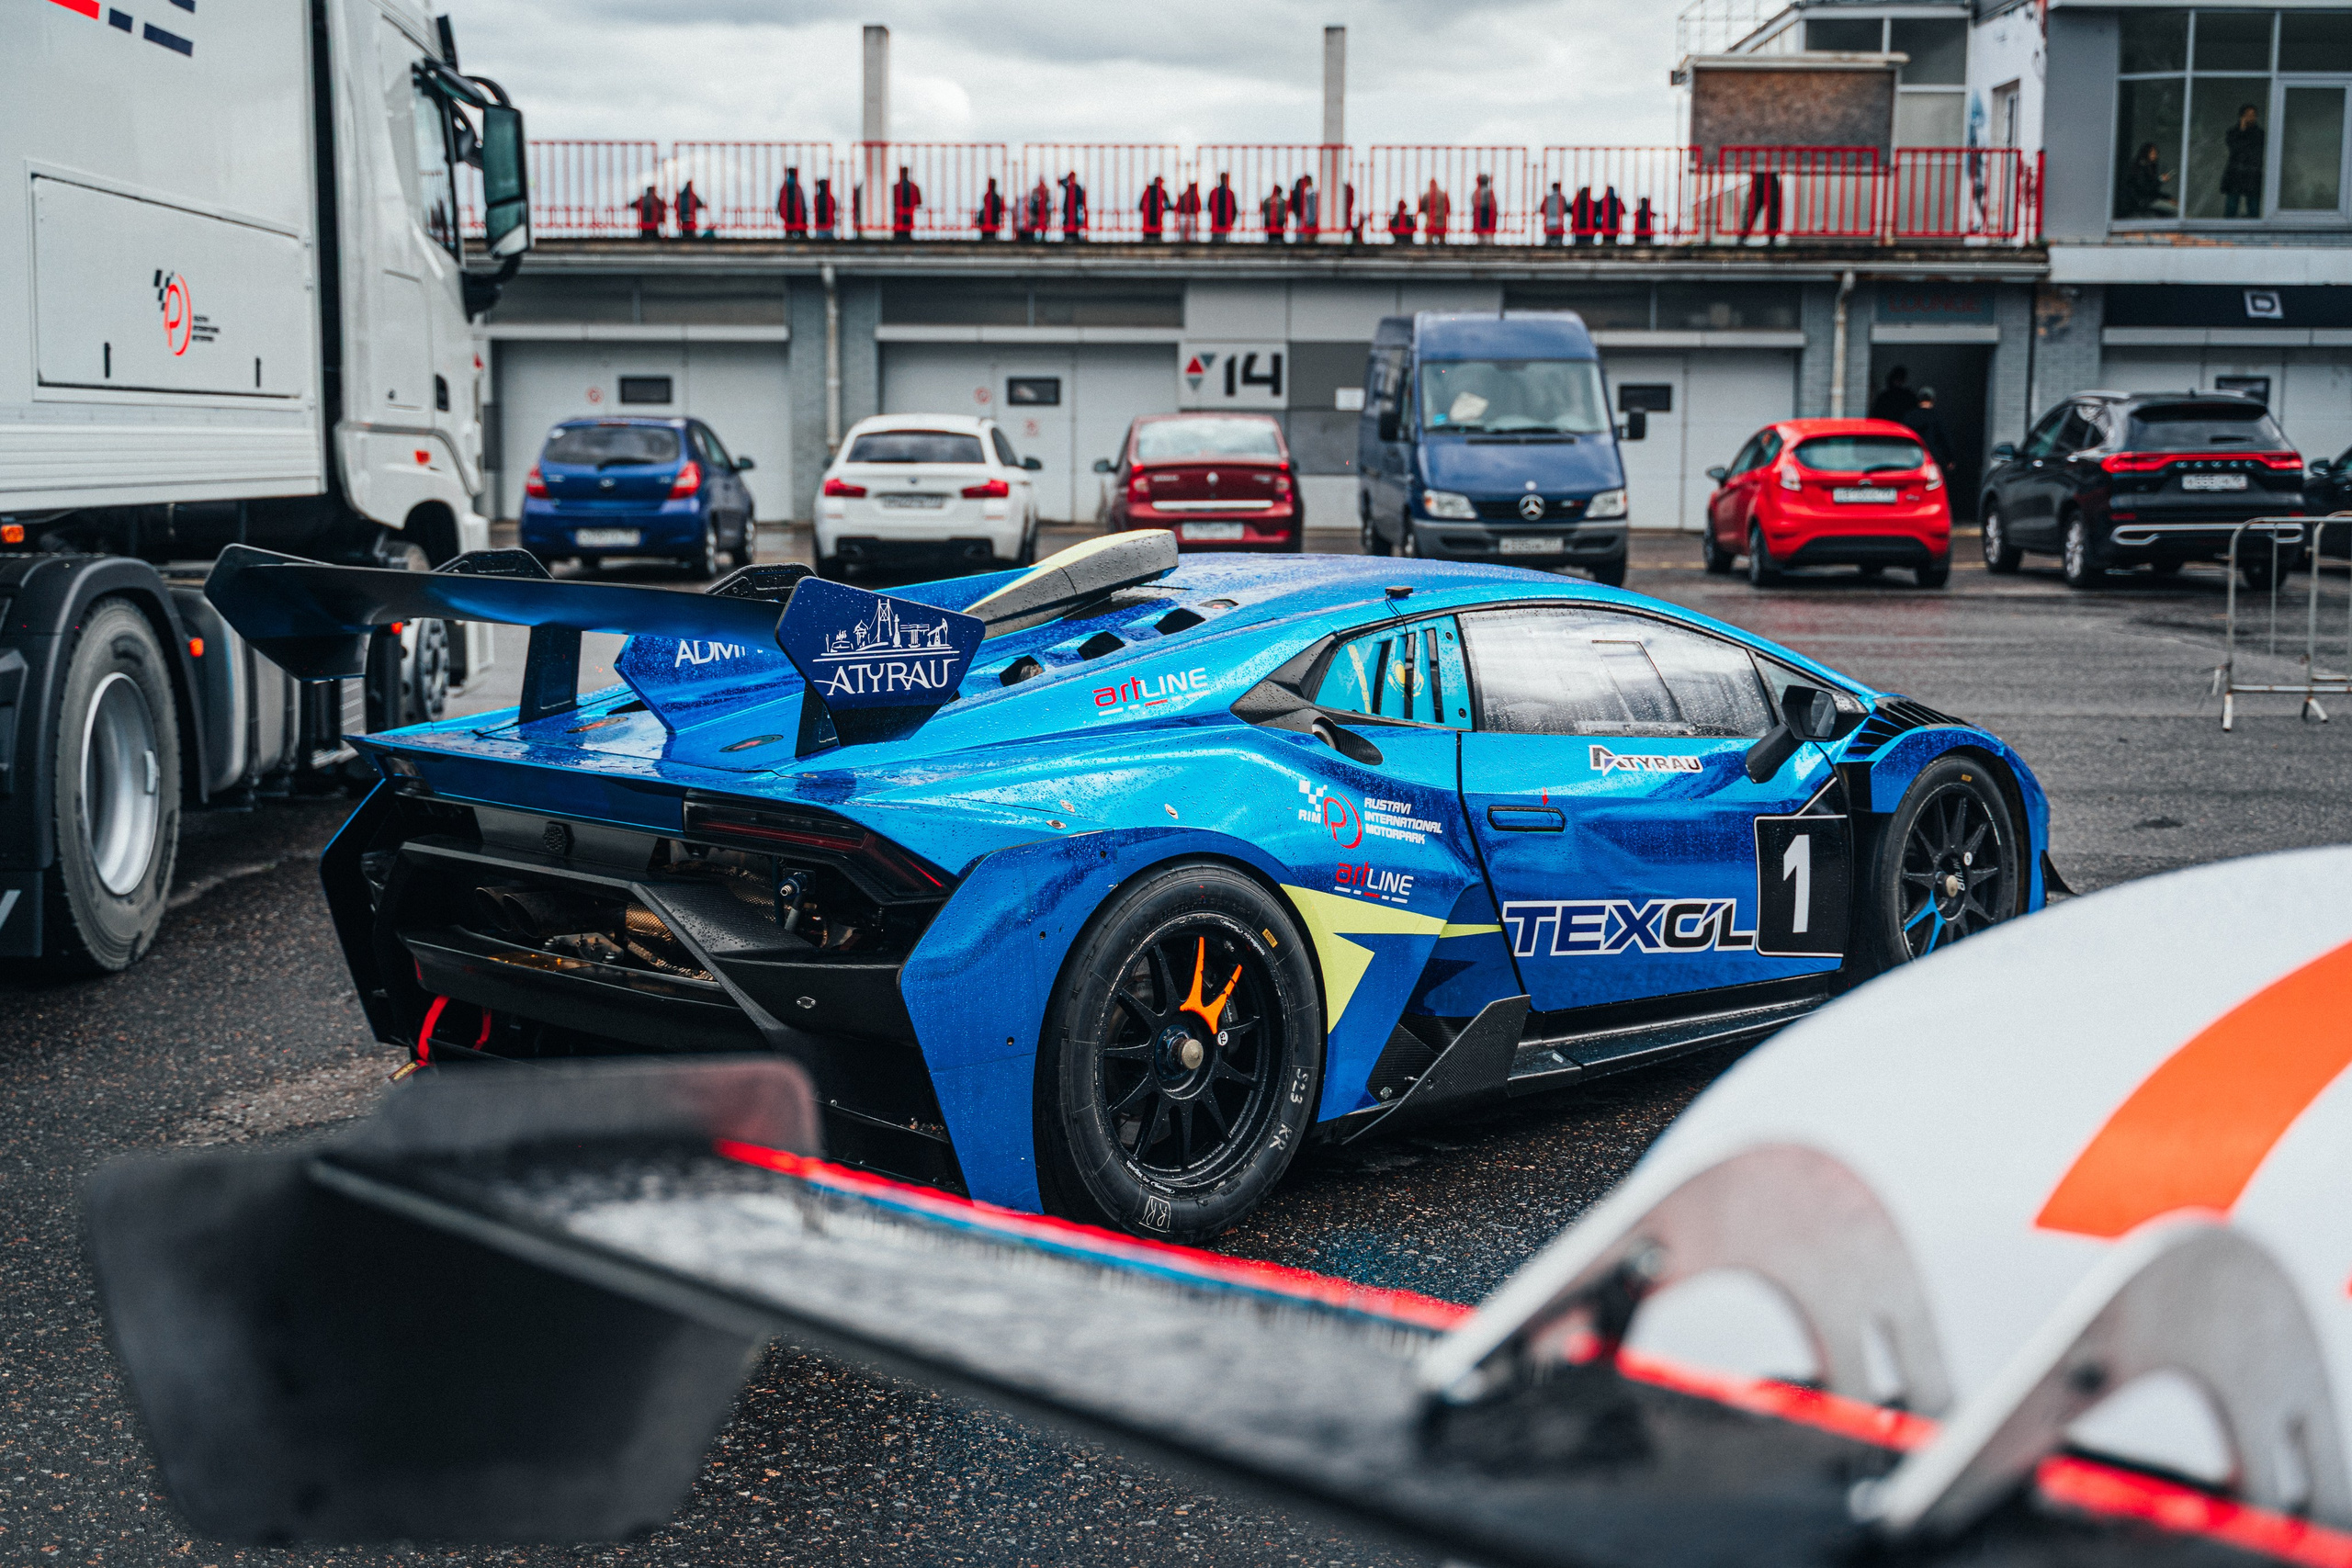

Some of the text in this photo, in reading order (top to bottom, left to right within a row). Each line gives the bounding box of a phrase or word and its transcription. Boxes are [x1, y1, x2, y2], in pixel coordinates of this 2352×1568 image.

[1225, 352, 1283, 398] 14
[814, 658, 960, 696] ATYRAU
[1092, 667, 1208, 707] artLINE
[1589, 745, 1702, 773] ATYRAU
[1298, 808, 1321, 824] RIM
[1364, 796, 1412, 815] RUSTAVI
[1364, 810, 1443, 834] INTERNATIONAL
[1365, 823, 1426, 845] MOTORPARK
[1335, 861, 1414, 896] artLINE
[1783, 834, 1809, 933] 1
[1502, 898, 1757, 957] TEXOL
